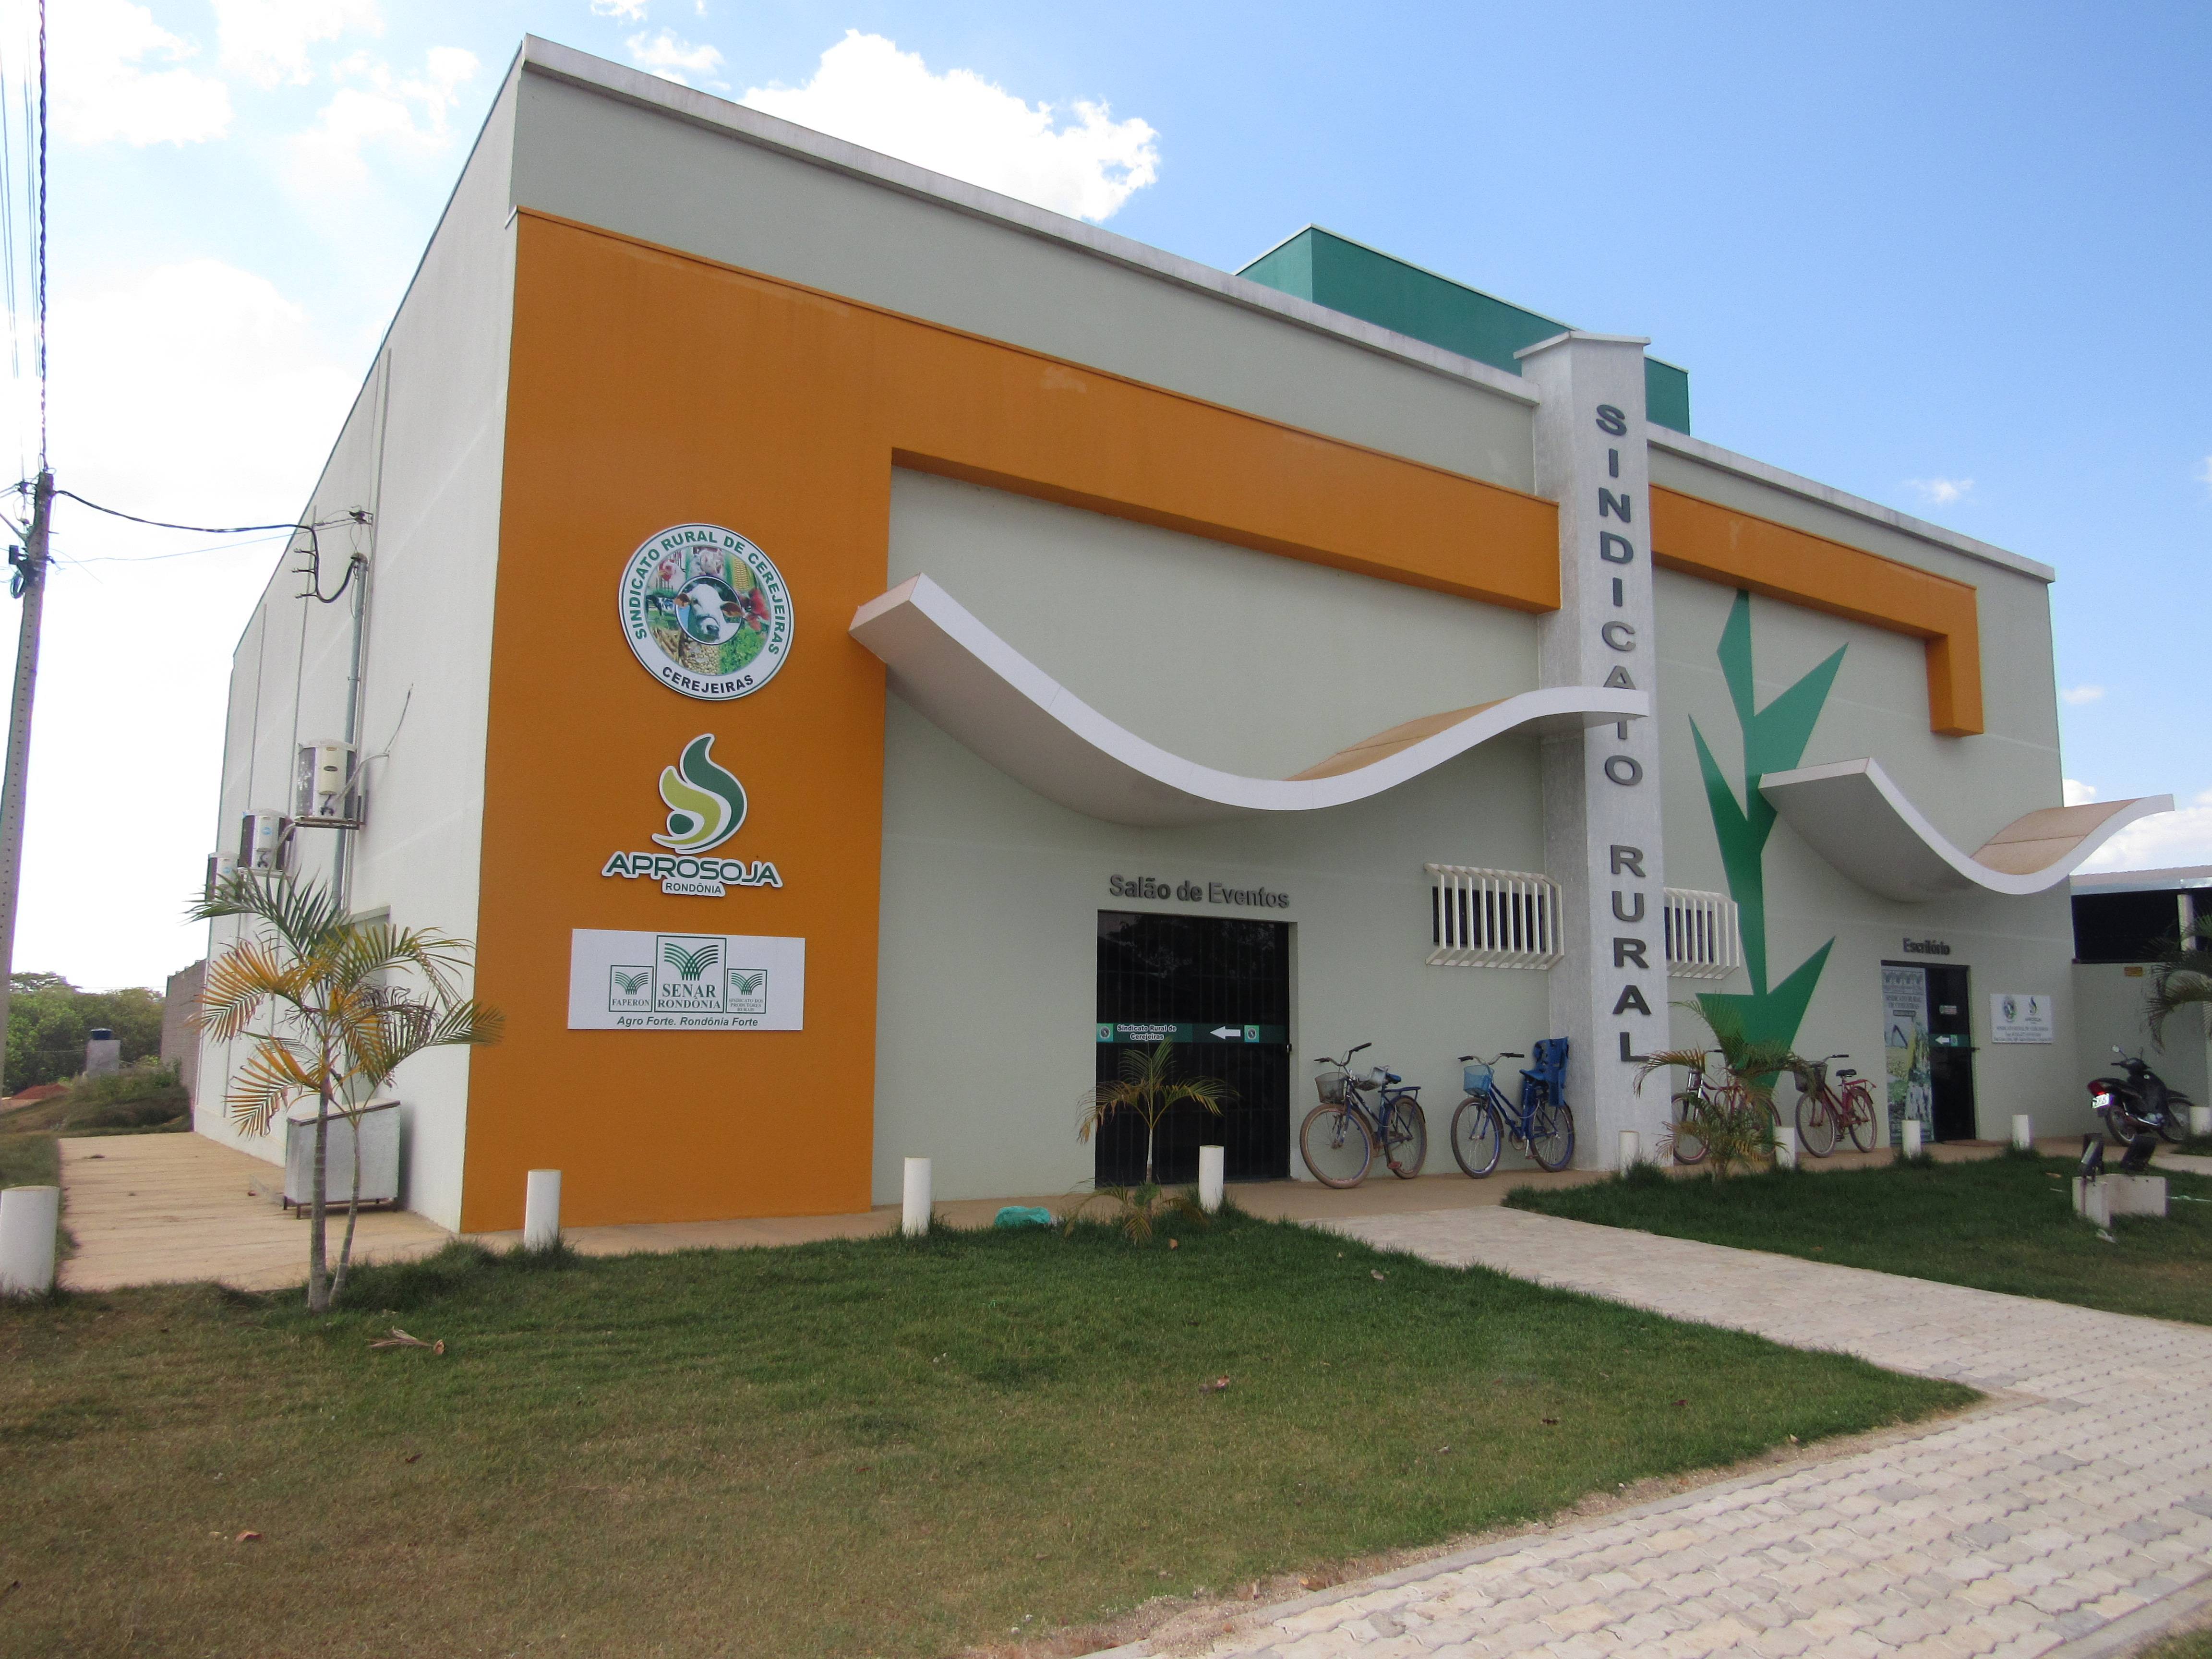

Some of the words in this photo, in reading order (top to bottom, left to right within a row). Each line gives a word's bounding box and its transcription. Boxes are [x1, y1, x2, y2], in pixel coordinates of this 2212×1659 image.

[629, 548, 661, 639] SINDICATO
[661, 530, 718, 552] RURAL
[723, 535, 745, 554] DE
[748, 553, 786, 655] CEREJEIRAS
[662, 666, 754, 694] CEREJEIRAS
[605, 853, 780, 885] APROSOJA
[666, 882, 721, 893] RONDÔNIA
[1109, 874, 1171, 900] Salão
[1177, 880, 1202, 902] de
[1208, 882, 1290, 908] Eventos
[1610, 844, 1652, 1062] RURAL
[662, 984, 716, 998] SENAR
[612, 998, 650, 1007] FAPERON
[658, 997, 721, 1009] RONDÔNIA
[617, 1016, 643, 1027] Agro
[647, 1016, 676, 1025] Forte.
[680, 1017, 729, 1026] Rondônia
[732, 1018, 758, 1026] Forte
[1130, 1033, 1165, 1041] Cerejeiras
